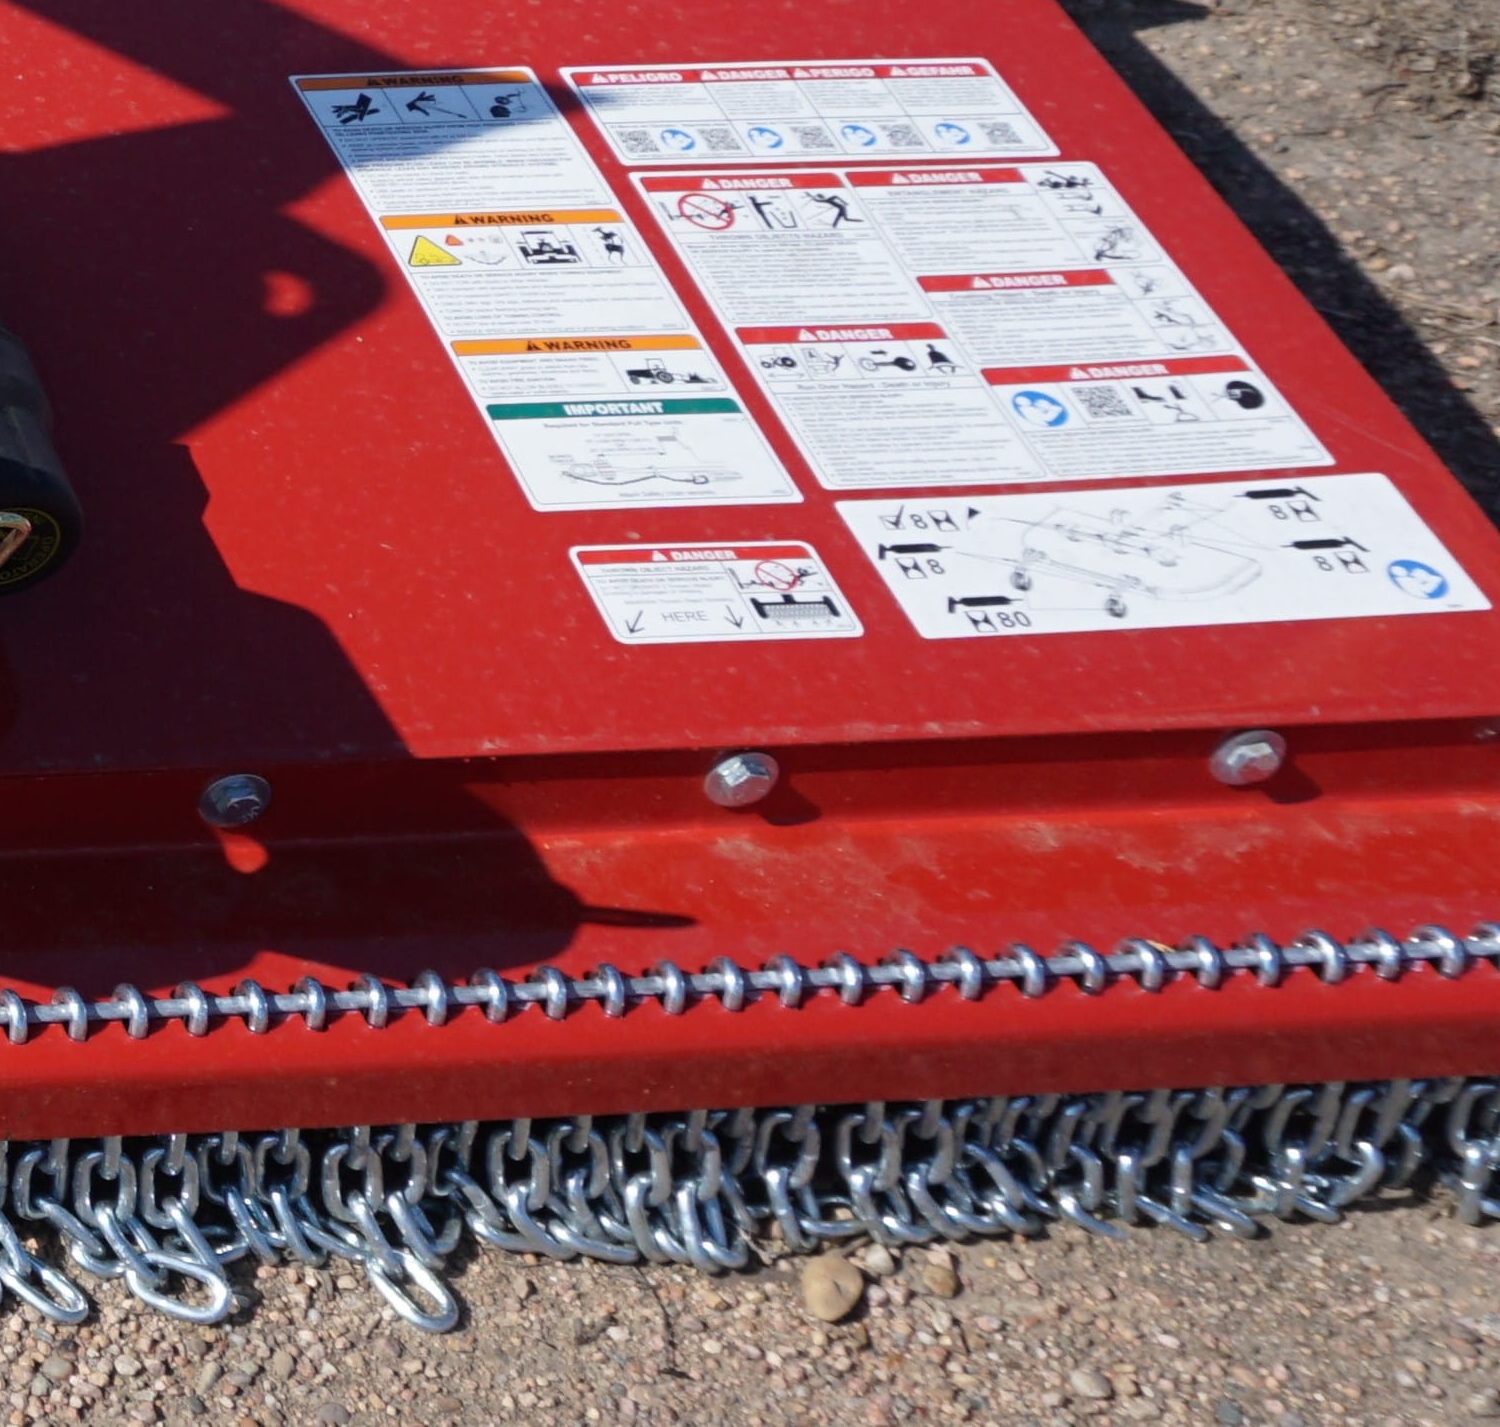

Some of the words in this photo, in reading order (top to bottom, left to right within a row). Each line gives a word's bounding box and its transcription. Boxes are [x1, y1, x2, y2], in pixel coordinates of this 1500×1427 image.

[719, 69, 788, 80] DANGER
[809, 67, 874, 79] PERIGO
[906, 65, 973, 77] GEFAHR
[386, 75, 465, 86] WARNING
[608, 71, 683, 84] PELIGRO
[718, 178, 792, 189] DANGER
[912, 173, 983, 183] DANGER
[468, 213, 556, 224] WARNING
[991, 275, 1067, 286] DANGER
[818, 328, 893, 340] DANGER
[543, 339, 632, 351] WARNING
[1091, 365, 1168, 378] DANGER
[563, 402, 664, 416] IMPORTANT
[1274, 504, 1289, 522] 8
[913, 511, 926, 530] 8
[671, 551, 737, 560] DANGER
[932, 557, 946, 576] 8
[1316, 555, 1332, 573] 8
[662, 611, 709, 622] HERE
[996, 610, 1032, 630] 80
